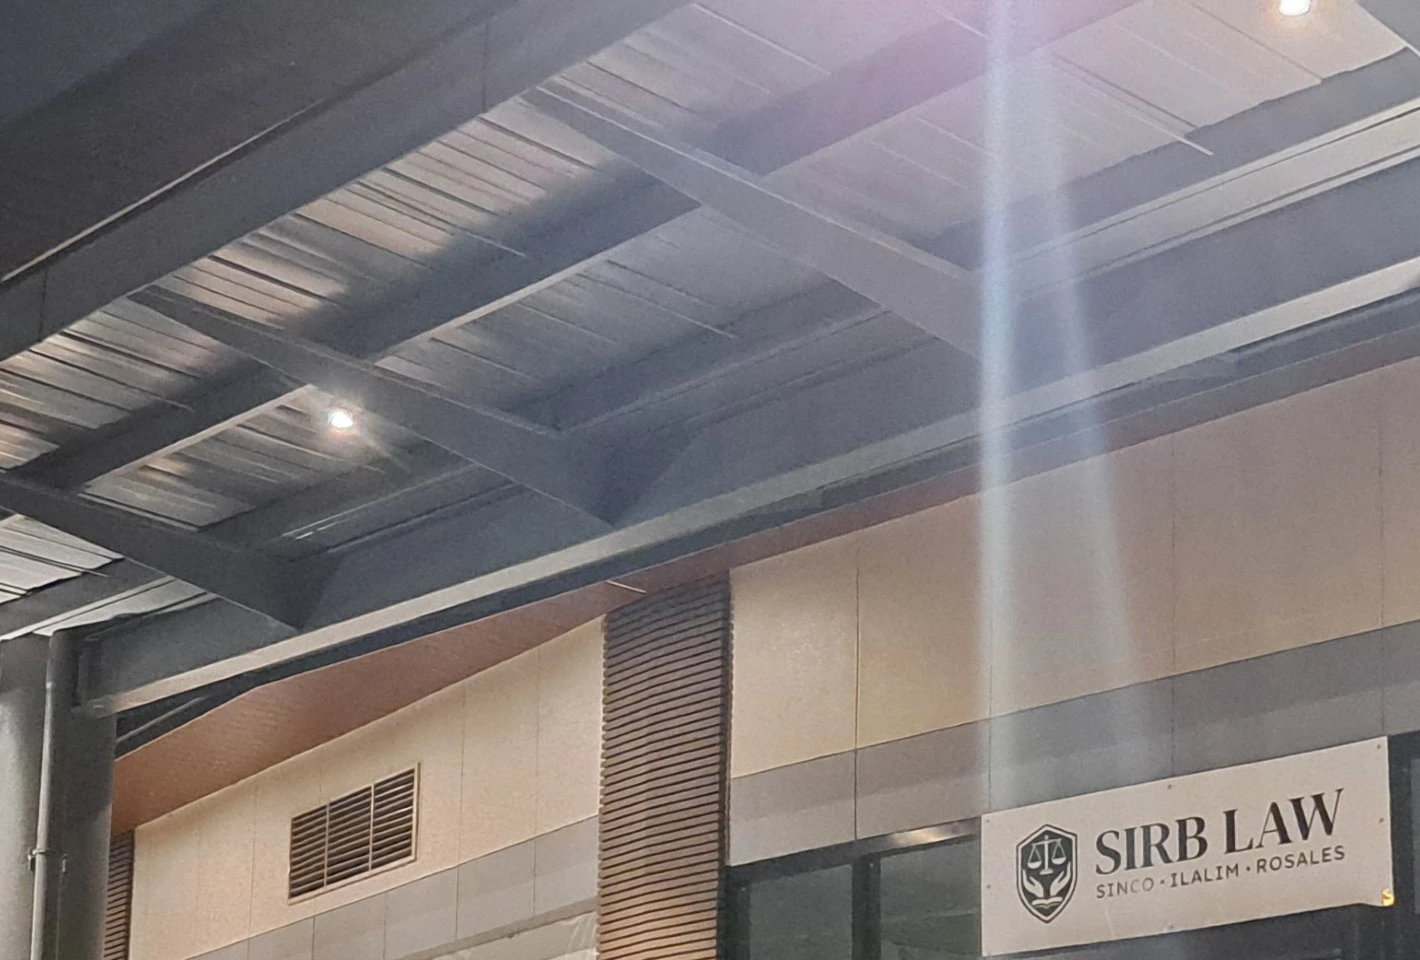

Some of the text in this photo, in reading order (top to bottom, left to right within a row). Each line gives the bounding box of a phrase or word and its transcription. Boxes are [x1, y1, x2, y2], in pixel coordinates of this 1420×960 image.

[1095, 788, 1344, 875] SIRB LAW
[1096, 845, 1345, 899] SINCO ILALIM ROSALES
